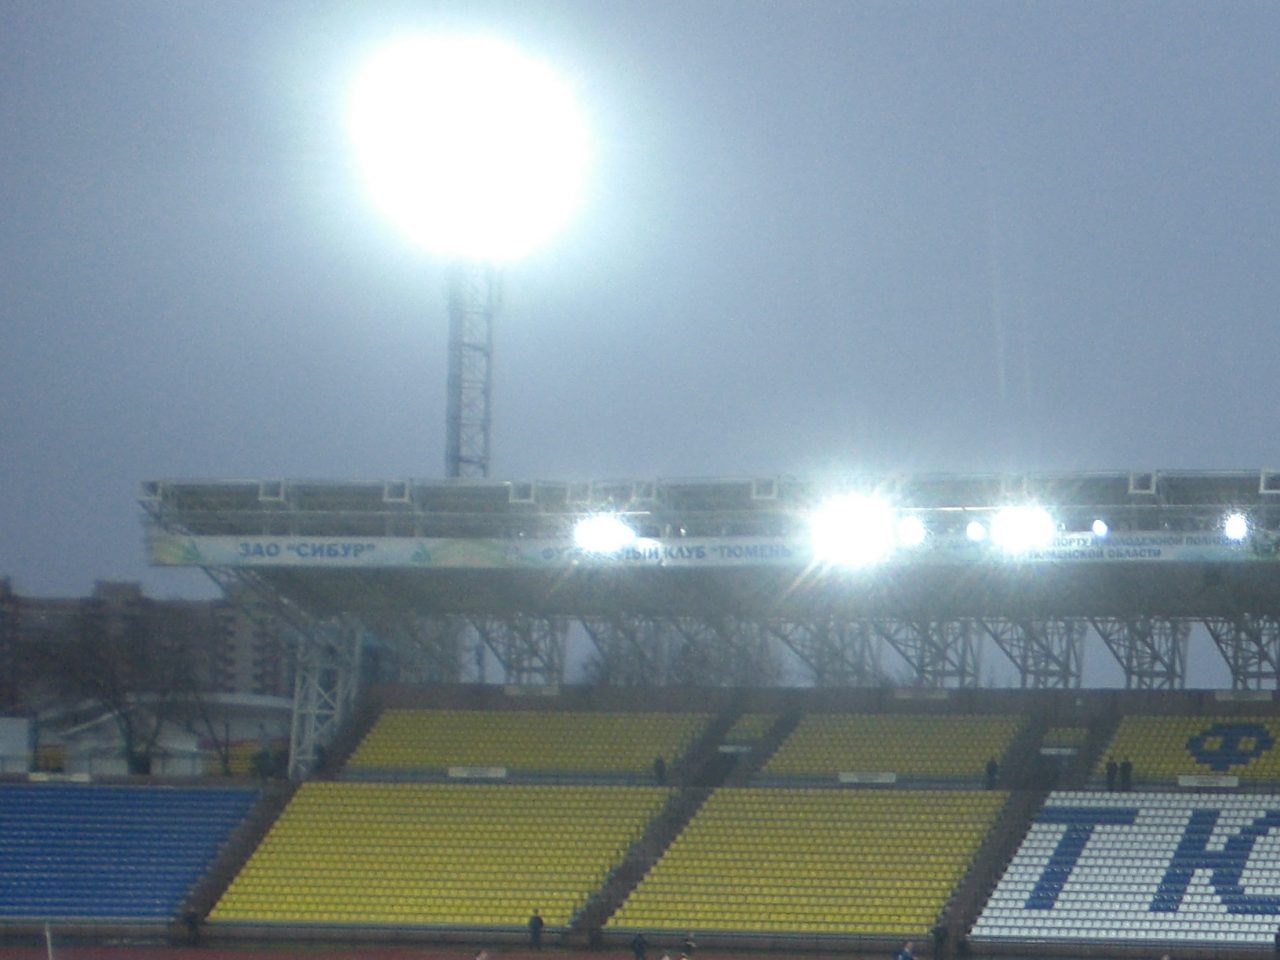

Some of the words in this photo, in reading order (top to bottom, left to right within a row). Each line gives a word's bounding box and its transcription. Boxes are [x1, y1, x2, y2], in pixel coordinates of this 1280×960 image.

[239, 542, 281, 558] ЗАО
[664, 545, 706, 560] КЛУБ
[1186, 723, 1275, 771] Ф
